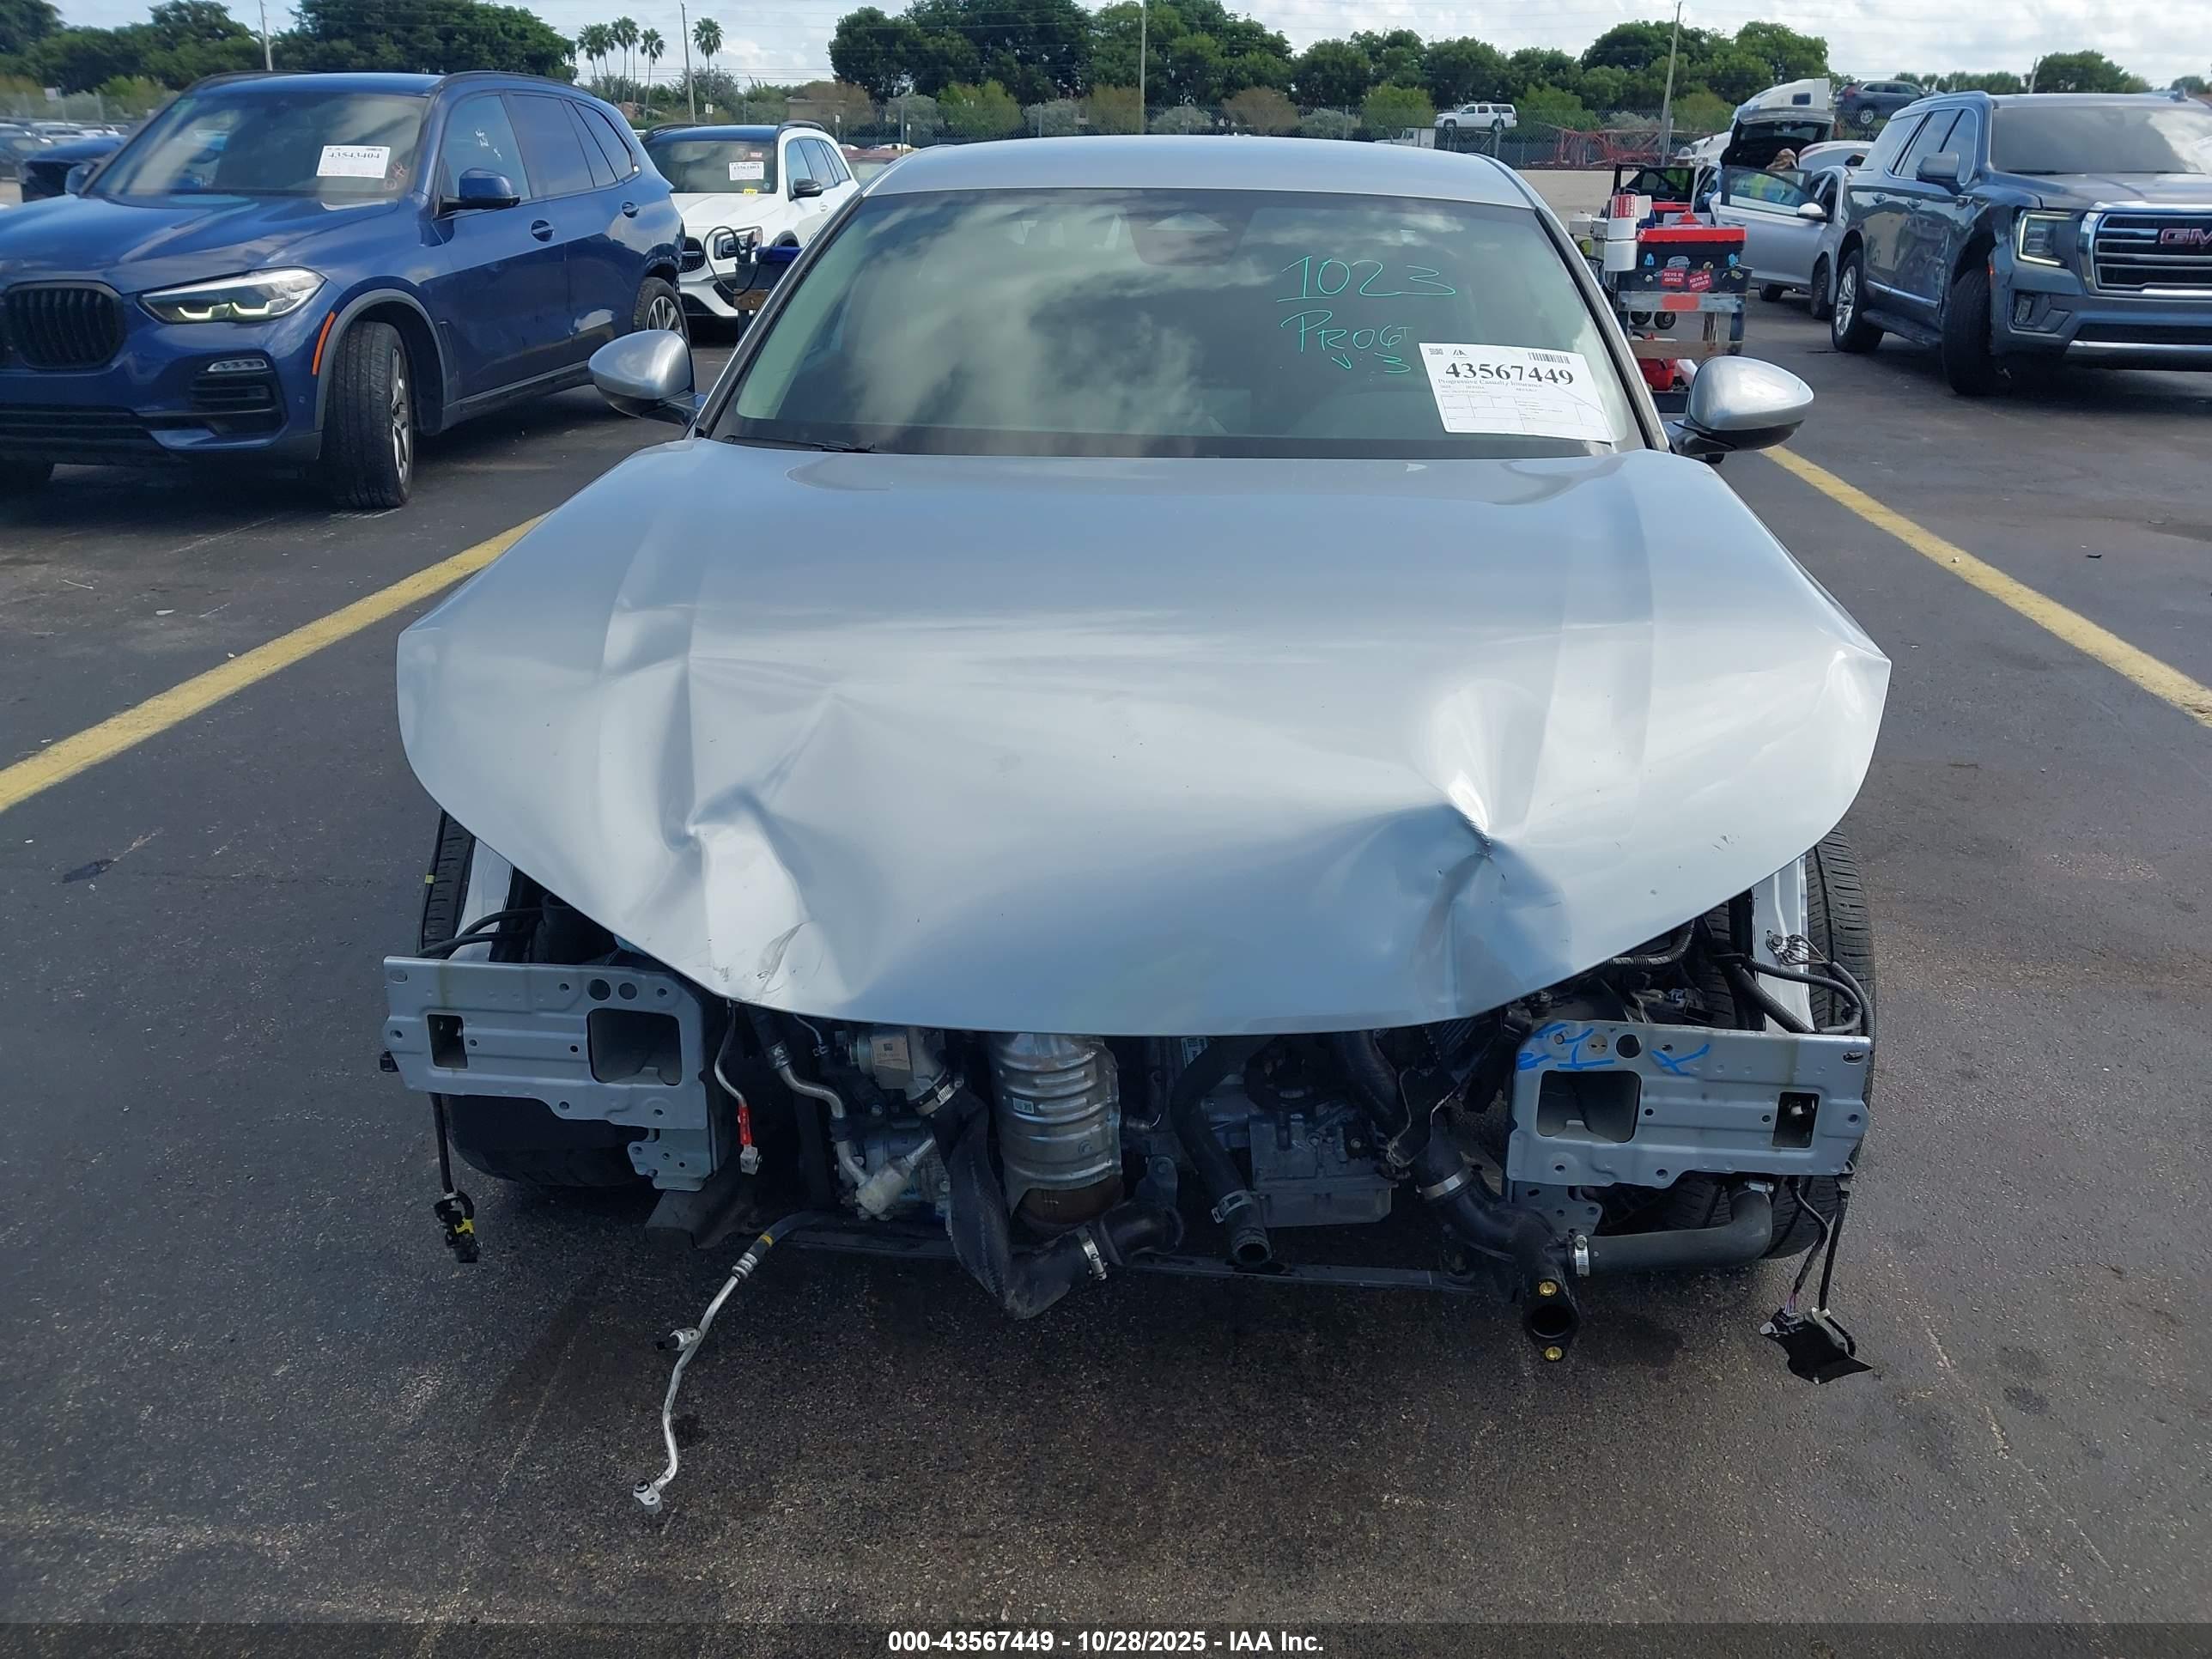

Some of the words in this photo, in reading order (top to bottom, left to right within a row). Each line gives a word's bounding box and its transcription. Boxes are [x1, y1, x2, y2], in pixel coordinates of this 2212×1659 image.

[2160, 228, 2212, 245] GM
[1276, 256, 1456, 302] 1023
[1692, 279, 1709, 289] OFFICE
[1445, 362, 1574, 386] 43567449
